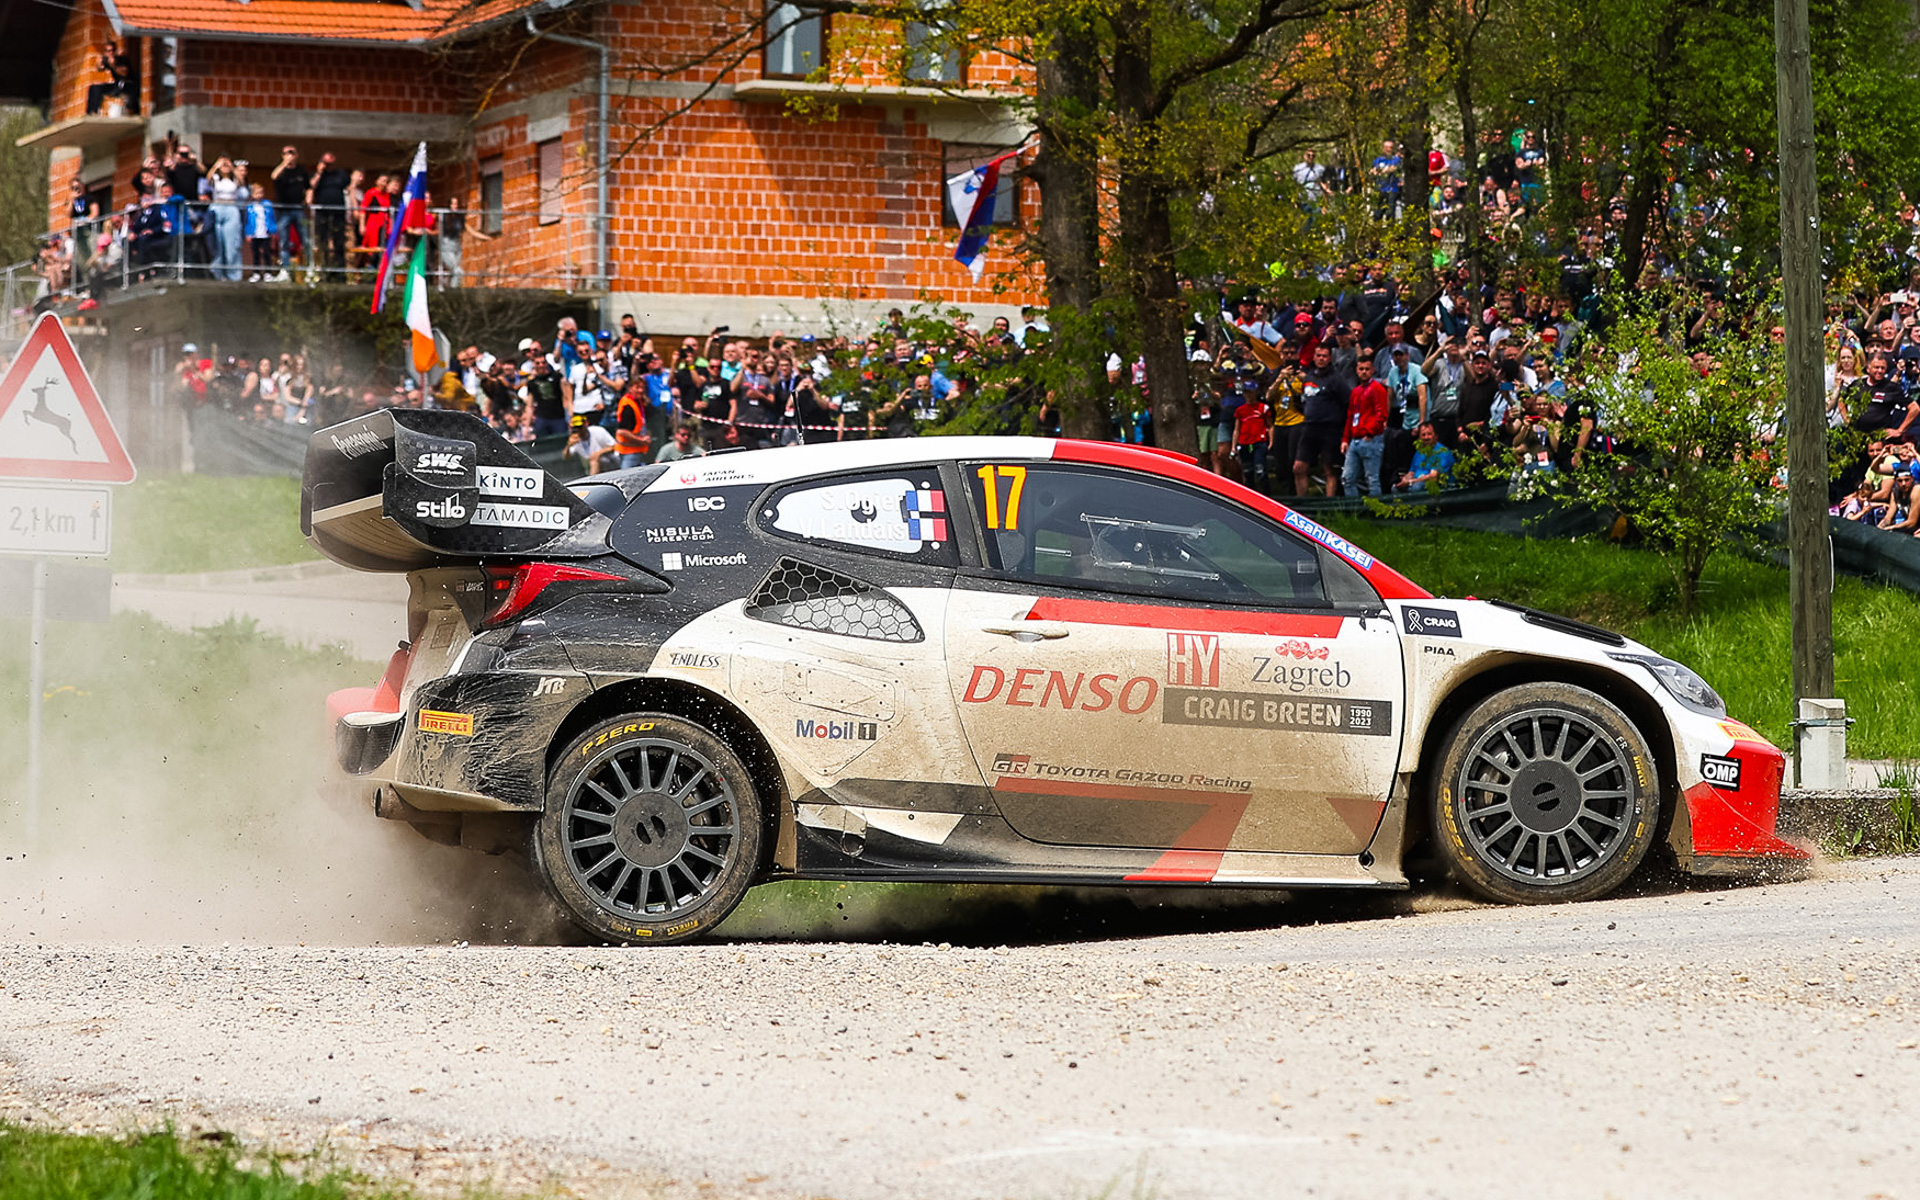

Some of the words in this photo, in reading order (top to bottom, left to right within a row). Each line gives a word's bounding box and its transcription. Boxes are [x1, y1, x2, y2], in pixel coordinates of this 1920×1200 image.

[416, 453, 468, 471] SWS
[416, 493, 466, 519] Stilo
[977, 464, 1027, 530] 17
[44, 506, 75, 534] km
[477, 507, 565, 525] TAMADIC
[646, 525, 714, 538] NISULA
[685, 552, 748, 567] Microsoft
[1423, 616, 1457, 628] CRAIG
[1166, 633, 1217, 686] HY
[1424, 645, 1455, 656] PIAA
[672, 653, 721, 668] ENDLESS
[1251, 656, 1351, 693] Zagreb
[962, 665, 1159, 715] DENSO
[1184, 696, 1256, 722] CRAIG
[1263, 701, 1342, 727] BREEN
[1350, 708, 1372, 717] 1990
[1350, 716, 1372, 726] 2023
[796, 719, 853, 740] Mobil
[1034, 763, 1109, 779] TOYOTA
[1188, 774, 1252, 791] Racing
[1703, 763, 1738, 782] OMP
